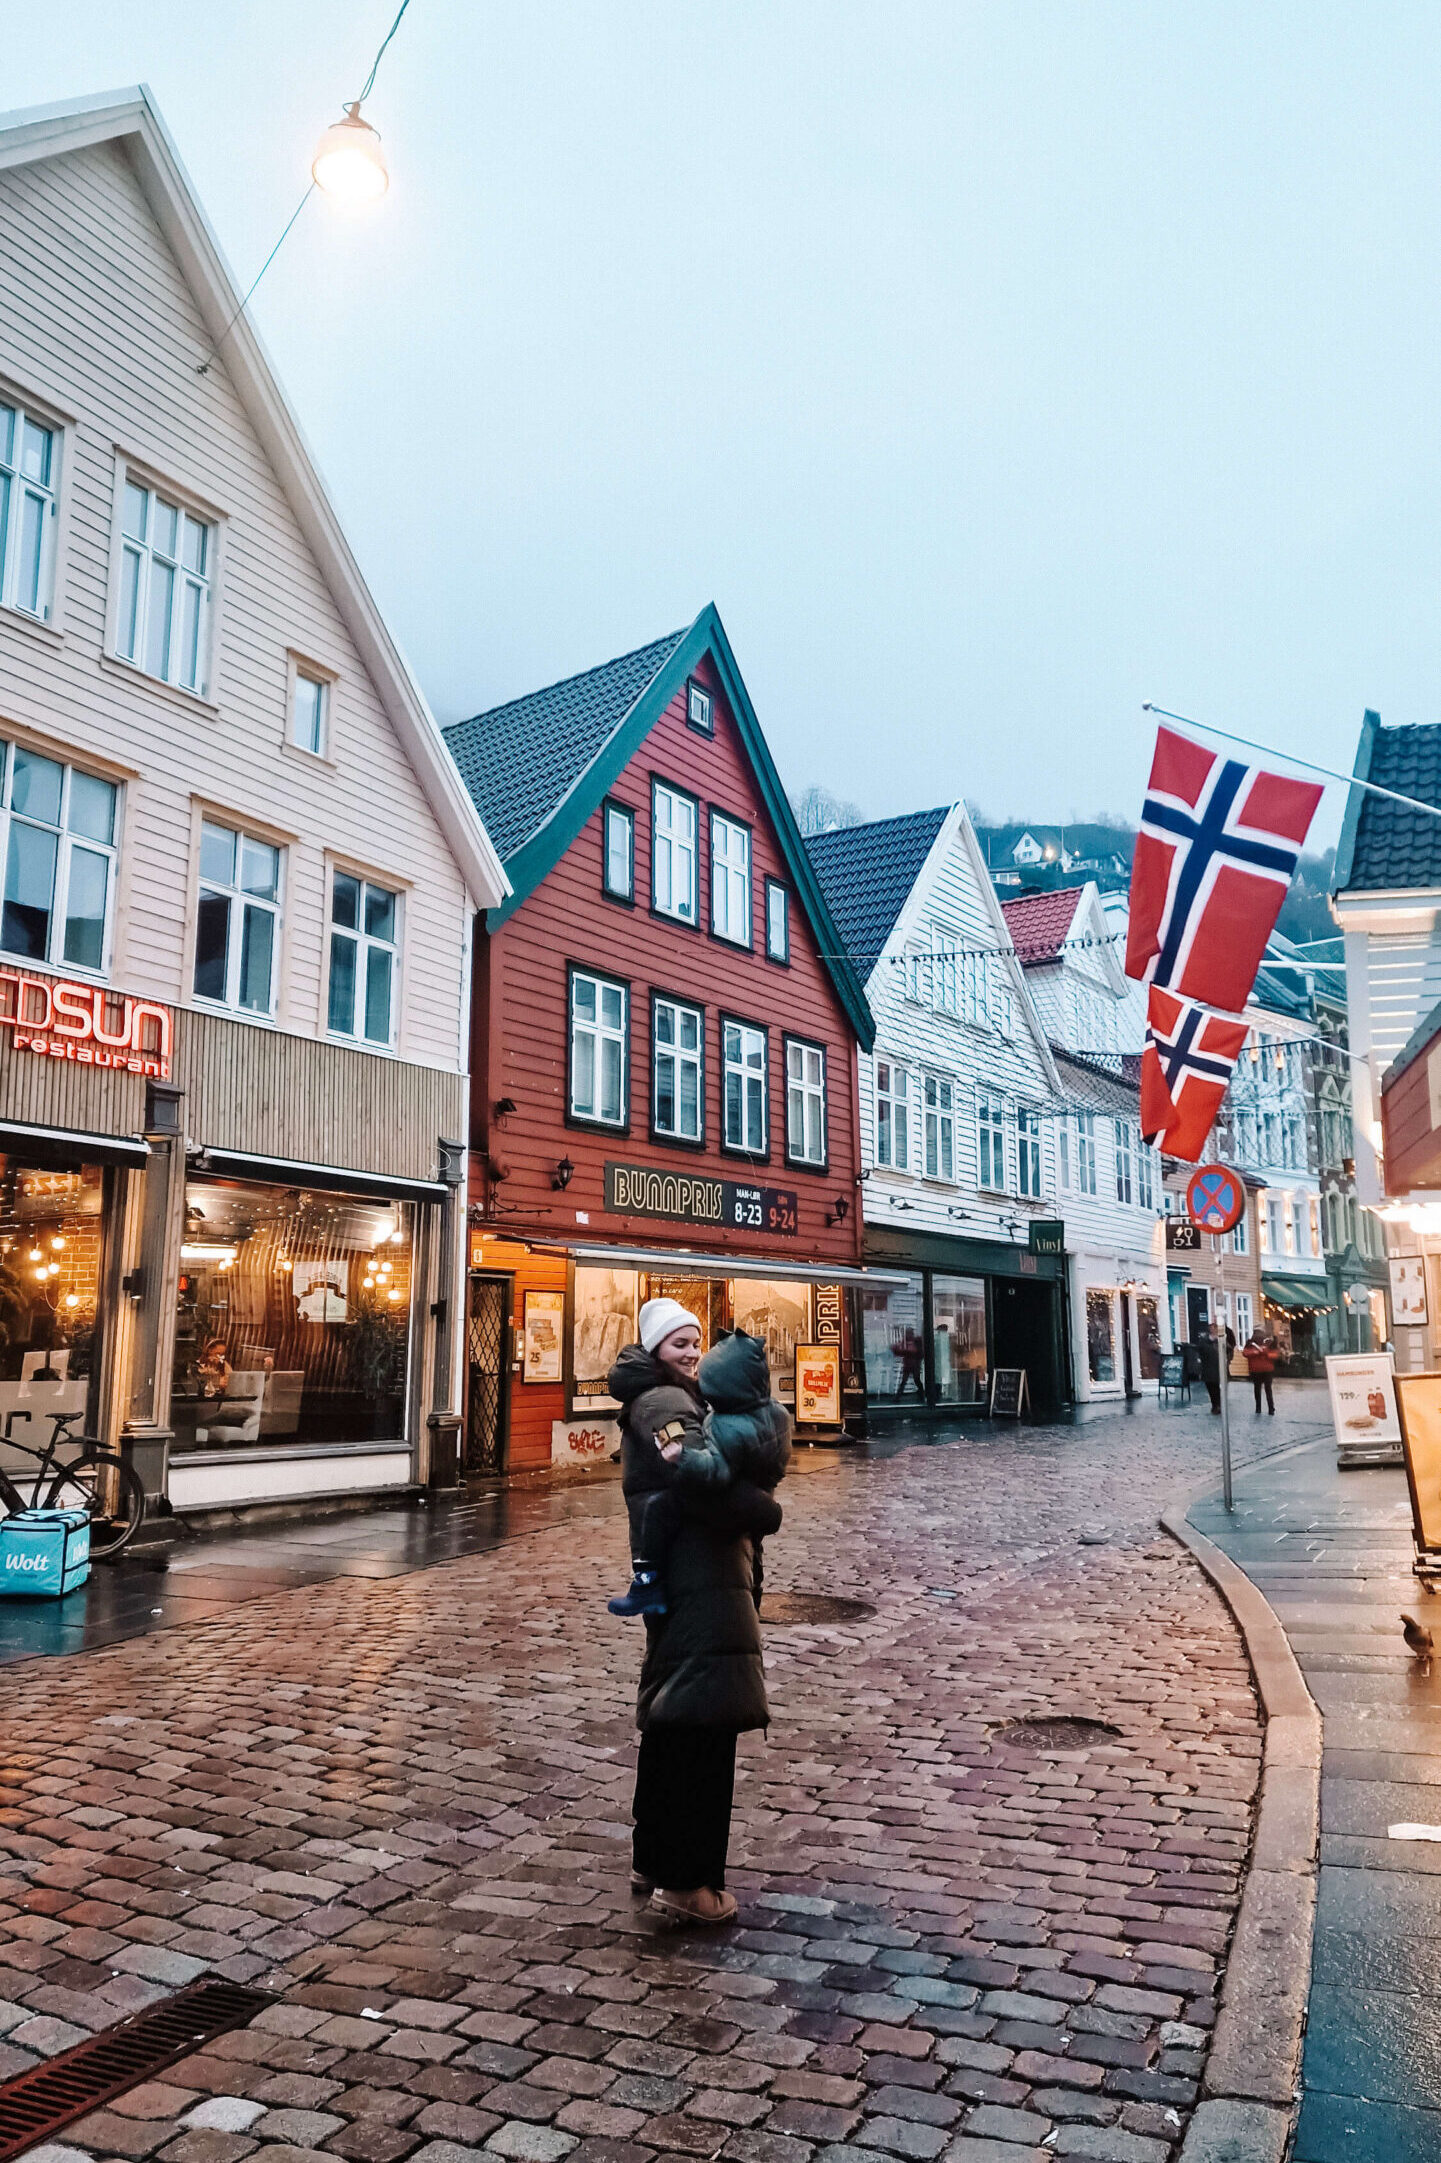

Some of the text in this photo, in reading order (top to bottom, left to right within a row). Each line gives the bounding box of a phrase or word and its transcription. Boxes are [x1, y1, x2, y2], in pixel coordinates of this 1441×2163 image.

[13, 1034, 170, 1078] restaurant
[614, 1167, 723, 1220] BUNNPRIS
[735, 1202, 762, 1225] 8-23
[769, 1207, 795, 1230] 9-24
[816, 1283, 840, 1344] PRIS
[5, 1553, 49, 1571] Wolt
